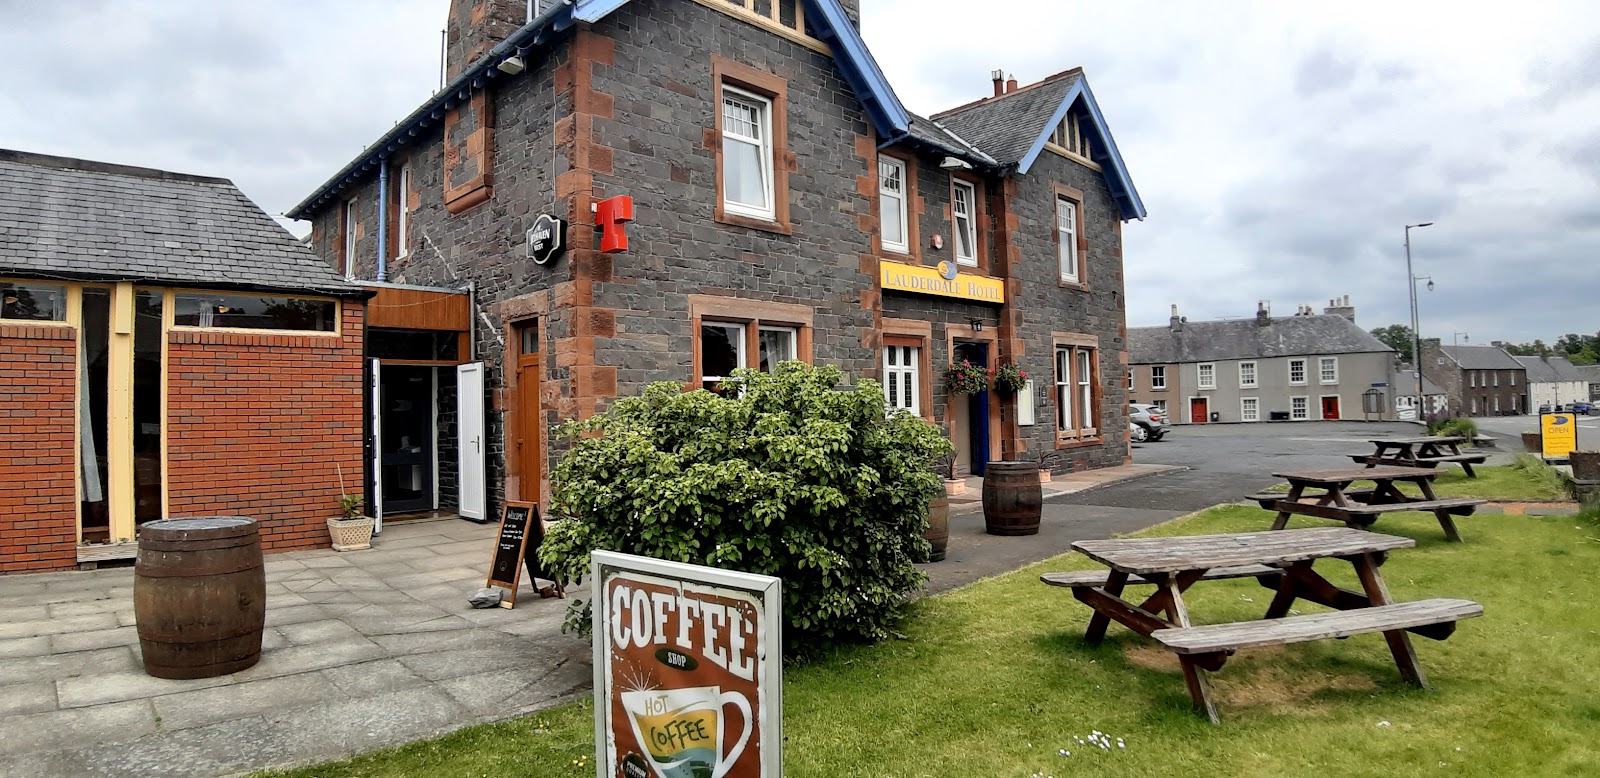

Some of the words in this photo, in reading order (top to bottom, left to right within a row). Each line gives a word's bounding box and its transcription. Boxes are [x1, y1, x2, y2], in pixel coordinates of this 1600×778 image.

[884, 269, 961, 295] LAUDERDALE
[967, 281, 1001, 300] HOTEL
[612, 585, 754, 682] COFFEE
[667, 651, 687, 667] SHOP
[645, 694, 669, 716] HOT
[650, 718, 709, 751] COFFEE
